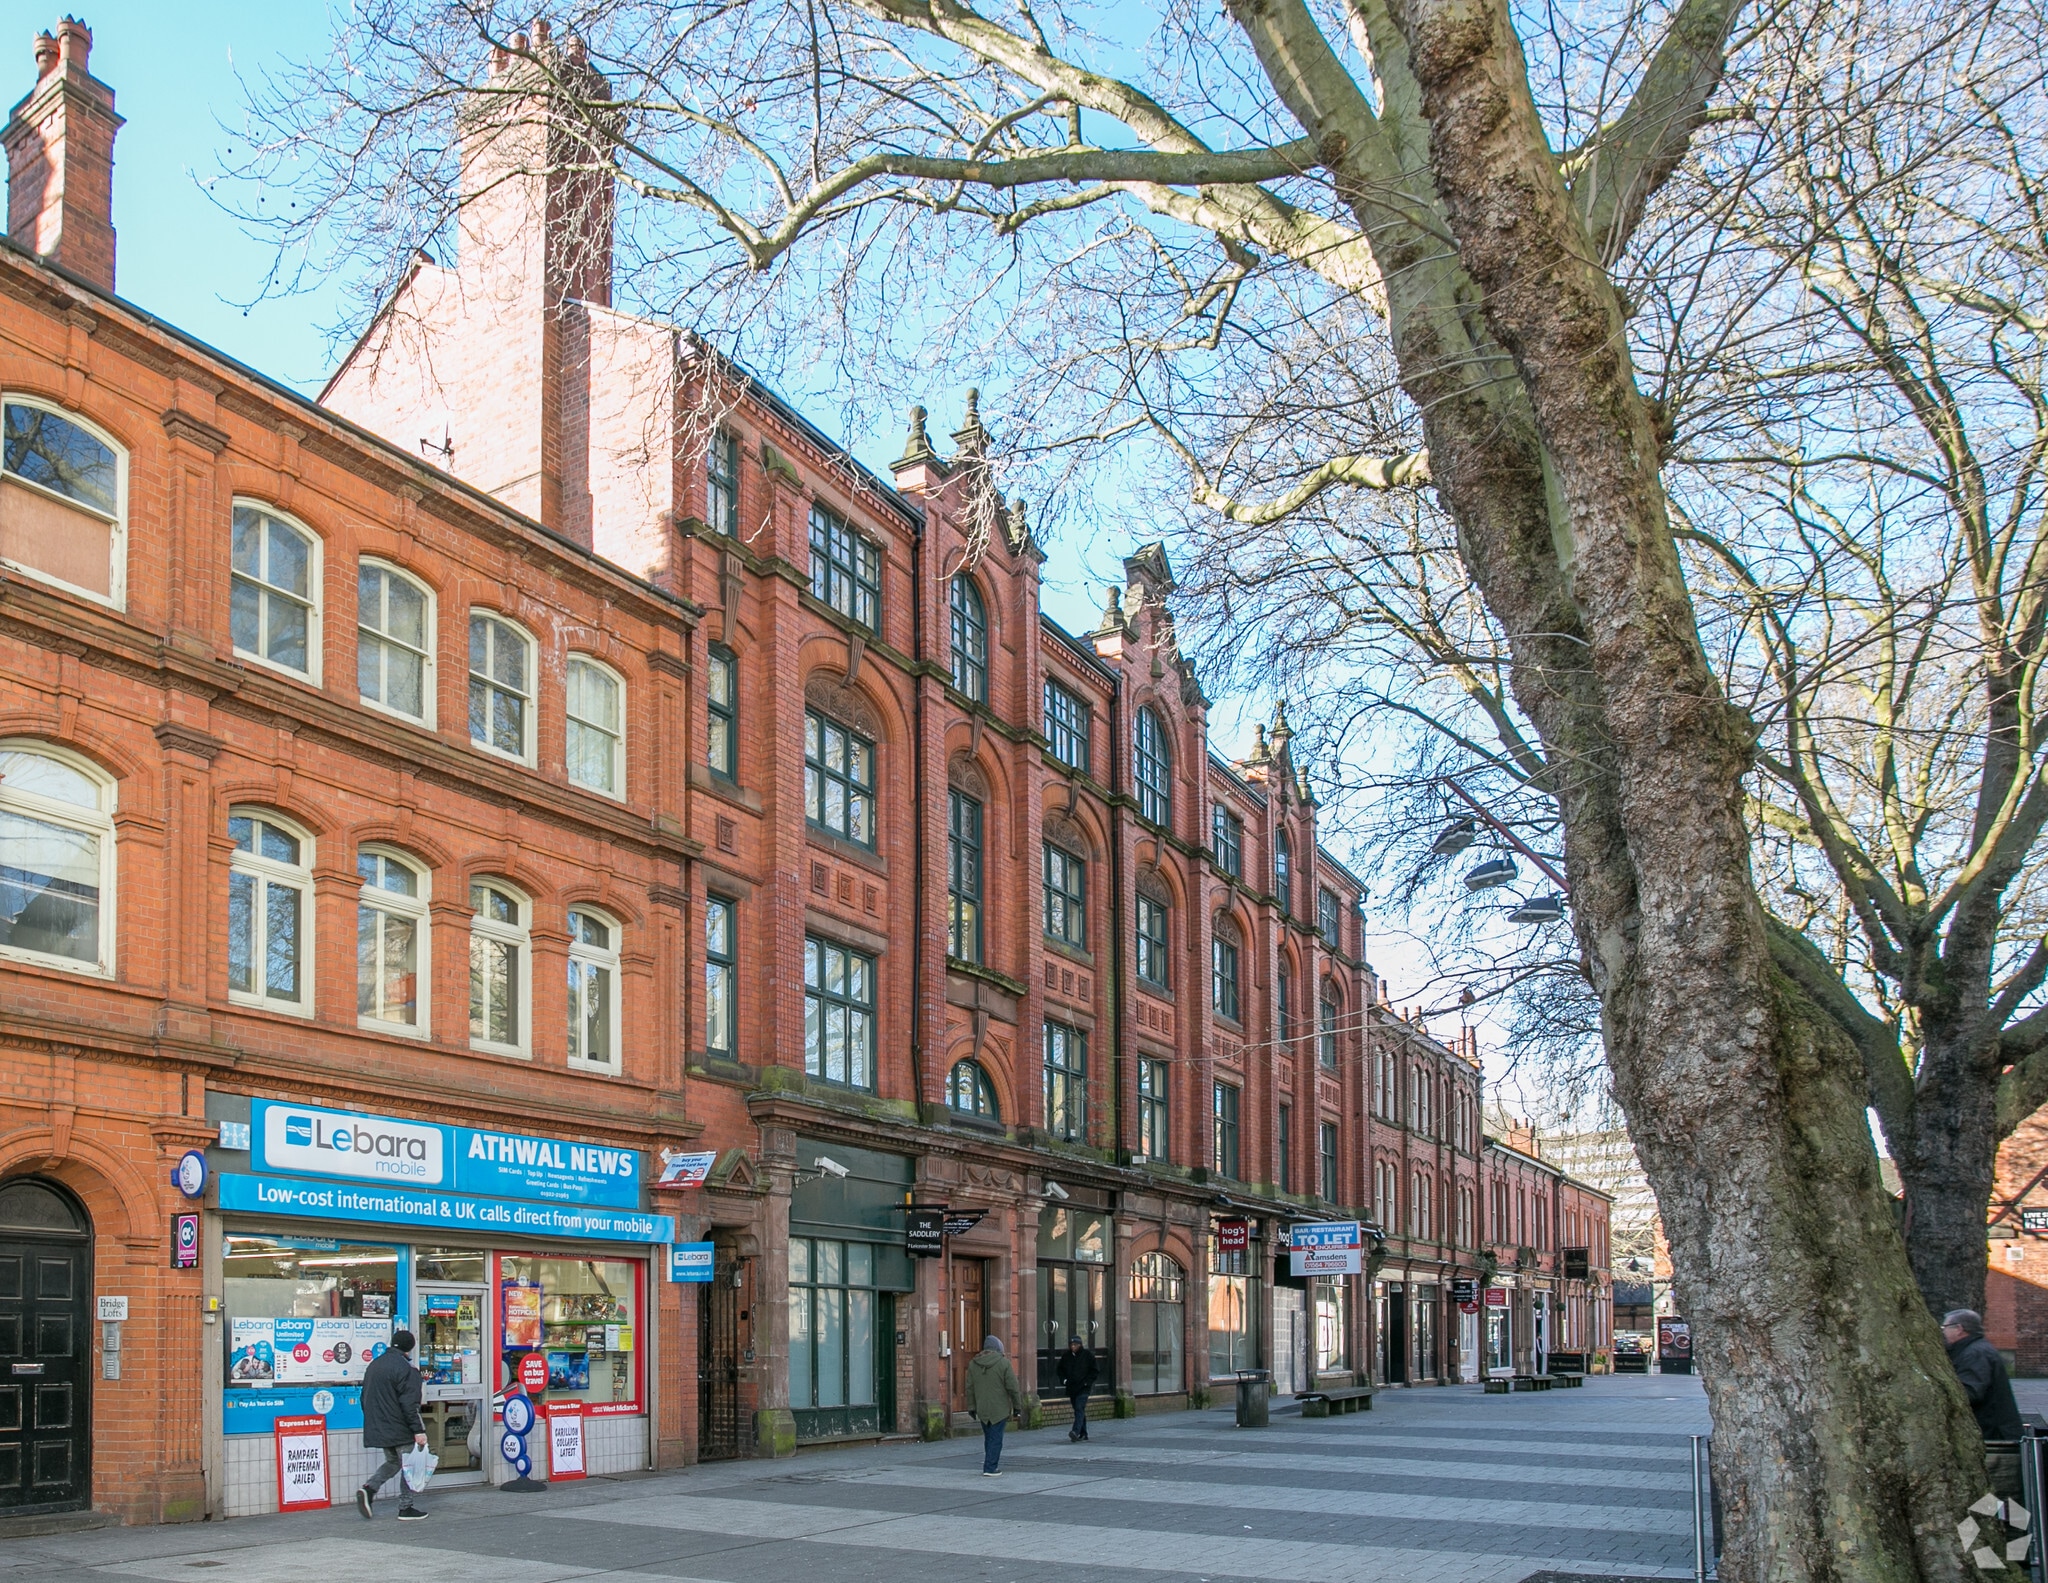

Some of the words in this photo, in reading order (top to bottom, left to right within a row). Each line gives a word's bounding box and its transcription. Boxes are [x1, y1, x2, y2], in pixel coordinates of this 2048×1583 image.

[316, 1119, 426, 1160] Lebara
[468, 1133, 565, 1170] ATHWAL
[571, 1146, 632, 1177] NEWS
[375, 1160, 426, 1176] mobile
[548, 1172, 574, 1180] Newsagents
[578, 1176, 607, 1184] Refreshments
[526, 1180, 546, 1188] Greeting
[258, 1183, 334, 1207] Low-cost
[337, 1191, 436, 1216] international
[440, 1202, 452, 1218] &
[456, 1202, 476, 1220] UK
[480, 1205, 510, 1222] calls
[514, 1207, 550, 1226] direct
[553, 1210, 582, 1228] from
[584, 1217, 610, 1234] your
[614, 1216, 652, 1234] mobile
[1222, 1226, 1244, 1236] hog's
[1222, 1236, 1244, 1245] head
[1298, 1234, 1319, 1246] TO
[1324, 1234, 1352, 1244] LET
[1307, 1250, 1347, 1260] Ramsdens
[100, 1299, 125, 1310] Bridge
[103, 1308, 122, 1318] Lofts
[233, 1320, 273, 1329] Lebara
[276, 1320, 311, 1329] Lebara
[316, 1320, 349, 1329] Lebara
[355, 1320, 388, 1329] Lebara
[555, 1428, 578, 1436] CARILLION
[557, 1438, 578, 1446] COLLAPSE
[288, 1449, 318, 1461] RAMPAGE
[560, 1448, 576, 1457] LATEST
[287, 1461, 320, 1473] KNIFEMAN
[292, 1473, 316, 1484] JAILED
